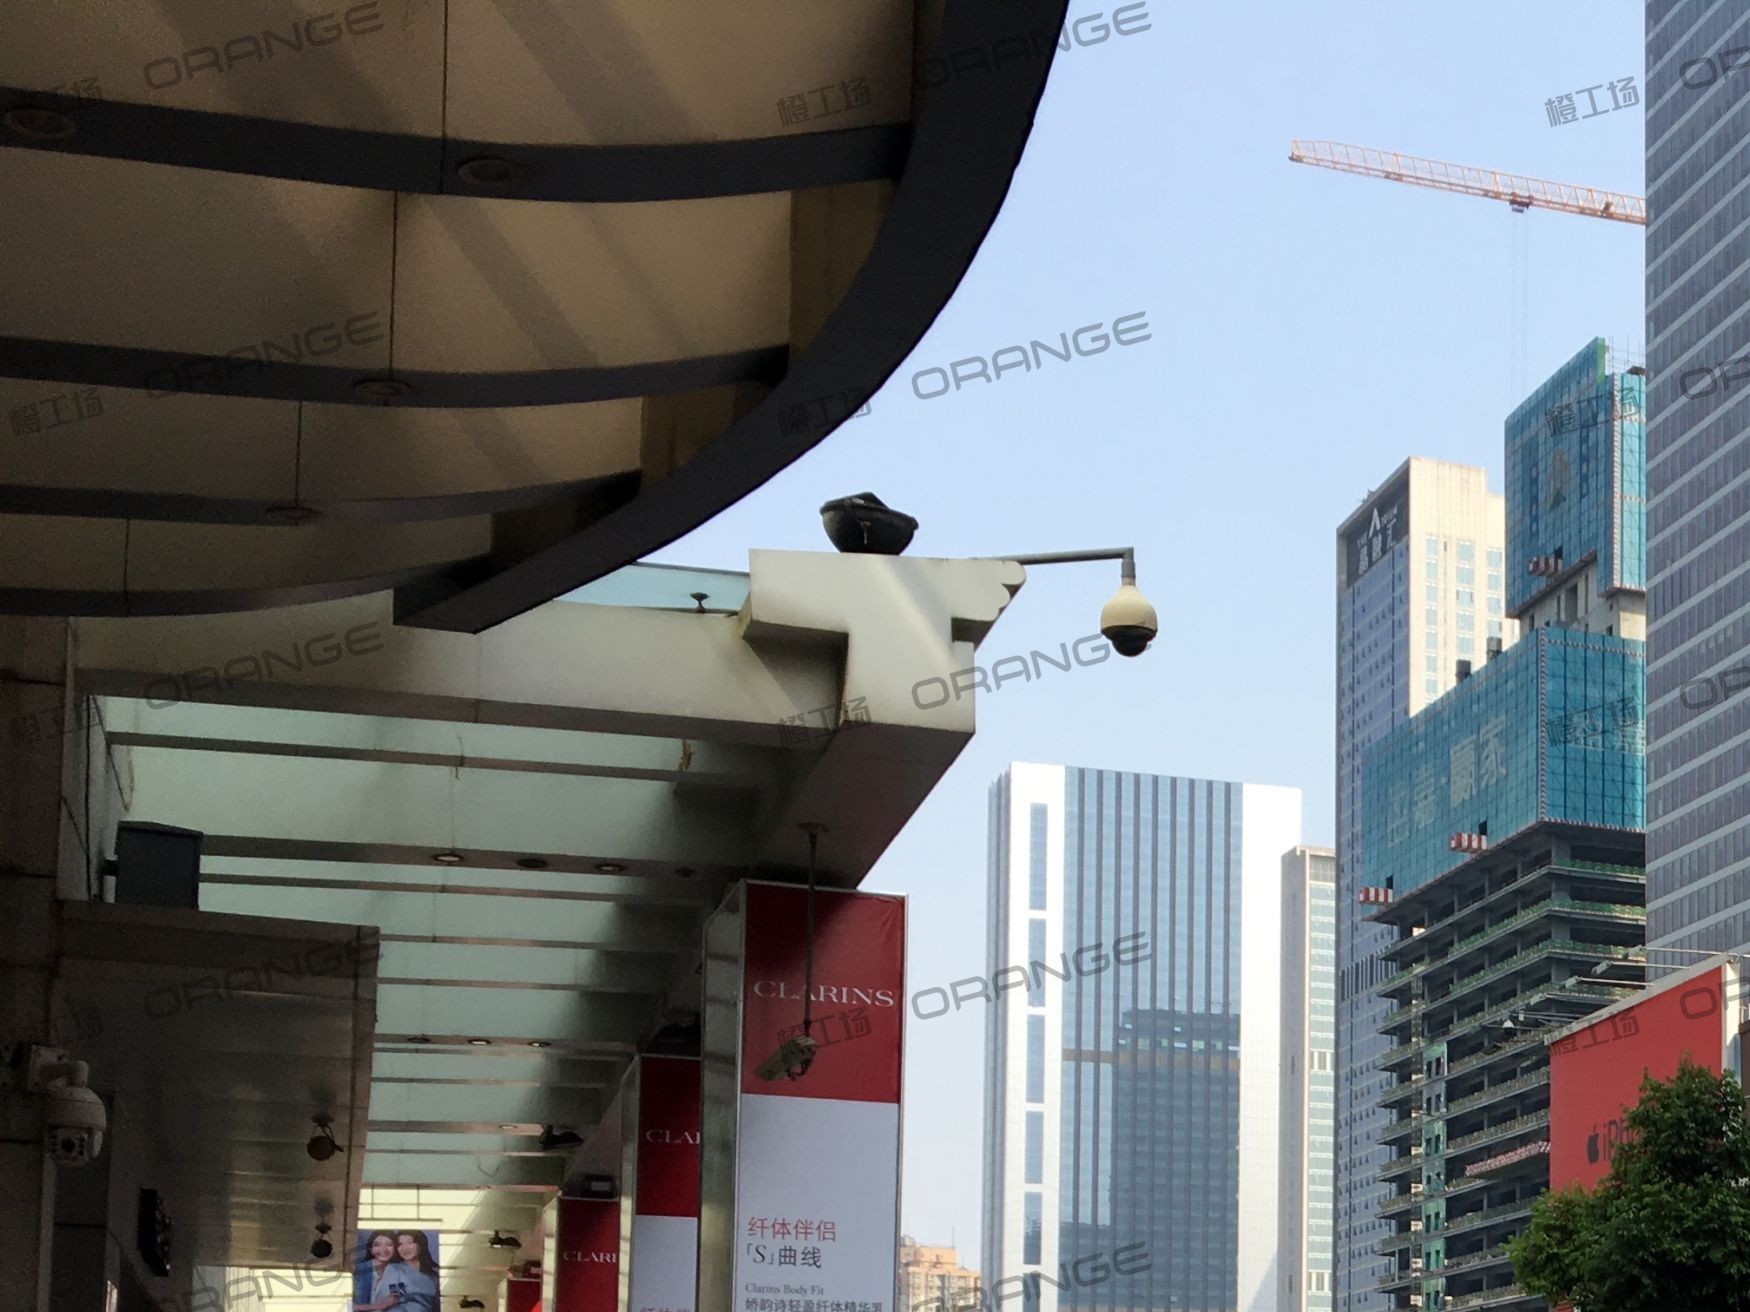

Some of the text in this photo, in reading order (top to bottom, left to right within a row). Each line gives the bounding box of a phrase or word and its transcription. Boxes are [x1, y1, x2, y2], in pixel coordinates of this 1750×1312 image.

[646, 1128, 700, 1145] CLA
[747, 1217, 837, 1243] 纤体伴侣
[784, 1283, 808, 1296] Body
